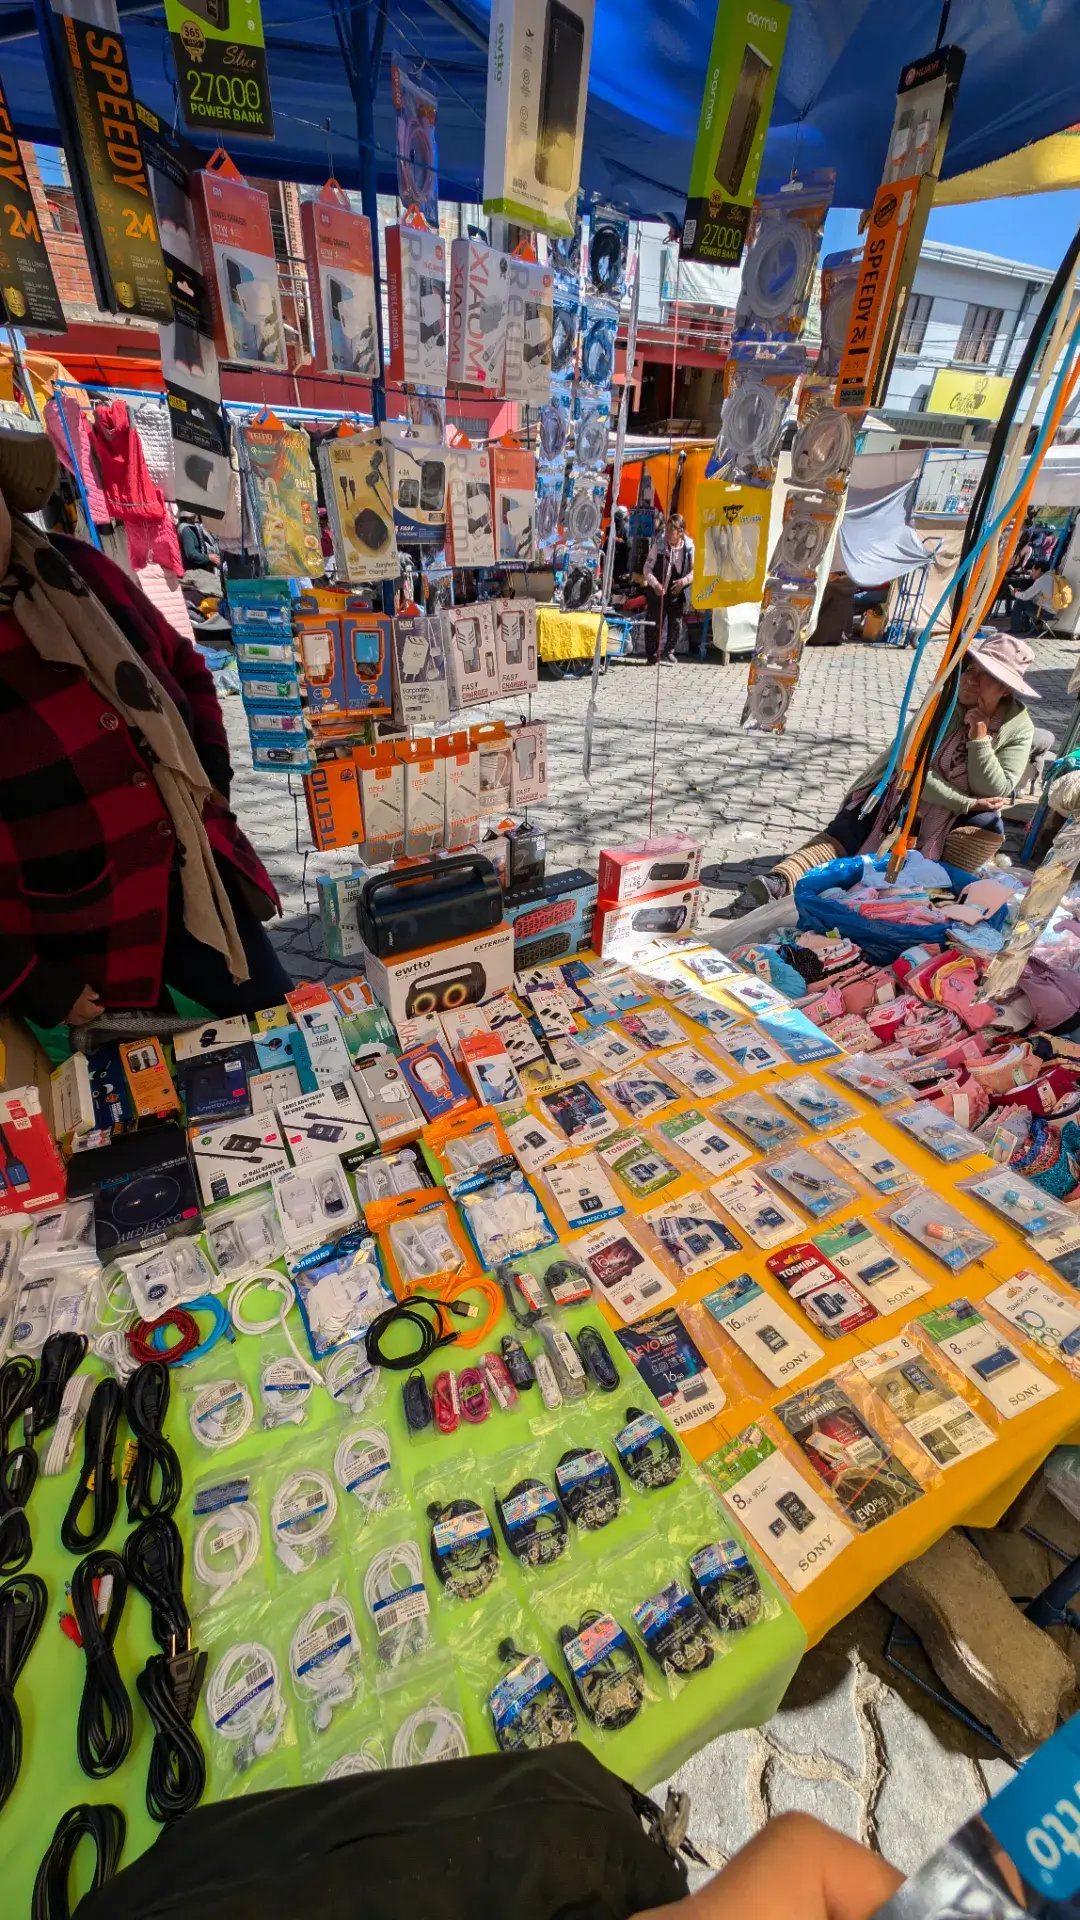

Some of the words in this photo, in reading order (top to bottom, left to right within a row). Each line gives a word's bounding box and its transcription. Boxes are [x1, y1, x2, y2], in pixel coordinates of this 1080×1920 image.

[183, 25, 201, 38] 365
[187, 71, 260, 110] 27000
[86, 30, 148, 197] SPEEDY
[190, 102, 231, 120] POWER
[233, 108, 264, 125] BANK
[4, 204, 41, 243] 2M
[122, 208, 157, 242] 2M
[701, 223, 742, 251] 27000
[700, 245, 721, 257] POWER
[855, 238, 886, 322] SPEEDY
[451, 263, 466, 363] XIAOMI
[461, 682, 478, 692] FAST
[501, 680, 528, 690] CHARGER
[502, 673, 519, 682] FAST
[461, 688, 489, 700] CHARGER
[310, 768, 338, 850] TECNO
[473, 935, 511, 952] EXTERIOR
[798, 1048, 836, 1062] SAMSUNG
[673, 1067, 688, 1077] 32
[583, 1127, 612, 1142] SAMSUNG
[677, 1137, 692, 1147] 16
[532, 1147, 556, 1167] SONY
[606, 1138, 640, 1156] TOSHIBA
[718, 1152, 741, 1169] SONY
[456, 1177, 486, 1192] SAMSUNG
[730, 1203, 747, 1216] 16
[587, 1234, 616, 1254] SAMSUNG
[296, 1249, 331, 1270] SAMSUNG
[590, 1255, 610, 1270] 16
[779, 1257, 820, 1279] TOSHIBA
[835, 1256, 850, 1268] 16
[819, 1271, 829, 1281] 8
[886, 1285, 916, 1306] SONY
[726, 1319, 742, 1332] 16
[635, 1340, 661, 1355] EVO
[659, 1333, 677, 1345] Plus
[900, 1339, 910, 1349] 8
[949, 1342, 962, 1355] 8
[780, 1351, 809, 1375] SONY
[1008, 1384, 1042, 1407] SONY
[673, 1402, 715, 1427] SAMSUNG
[799, 1401, 837, 1424] SAMSUNG
[930, 1439, 949, 1453] SONY
[356, 1466, 382, 1485] ORIGINAL
[887, 1472, 907, 1495] 8
[732, 1493, 747, 1511] 8
[856, 1502, 875, 1522] EVO
[872, 1496, 888, 1510] Plus
[519, 1507, 547, 1525] ORIGINAL
[798, 1533, 836, 1573] SONY
[655, 1603, 682, 1629] ORIGINAL
[310, 1643, 341, 1667] ORIGINAL
[586, 1643, 617, 1670] ORIGINAL
[229, 1687, 262, 1717] ORIGINAL
[510, 1685, 541, 1715] ORIGINAL
